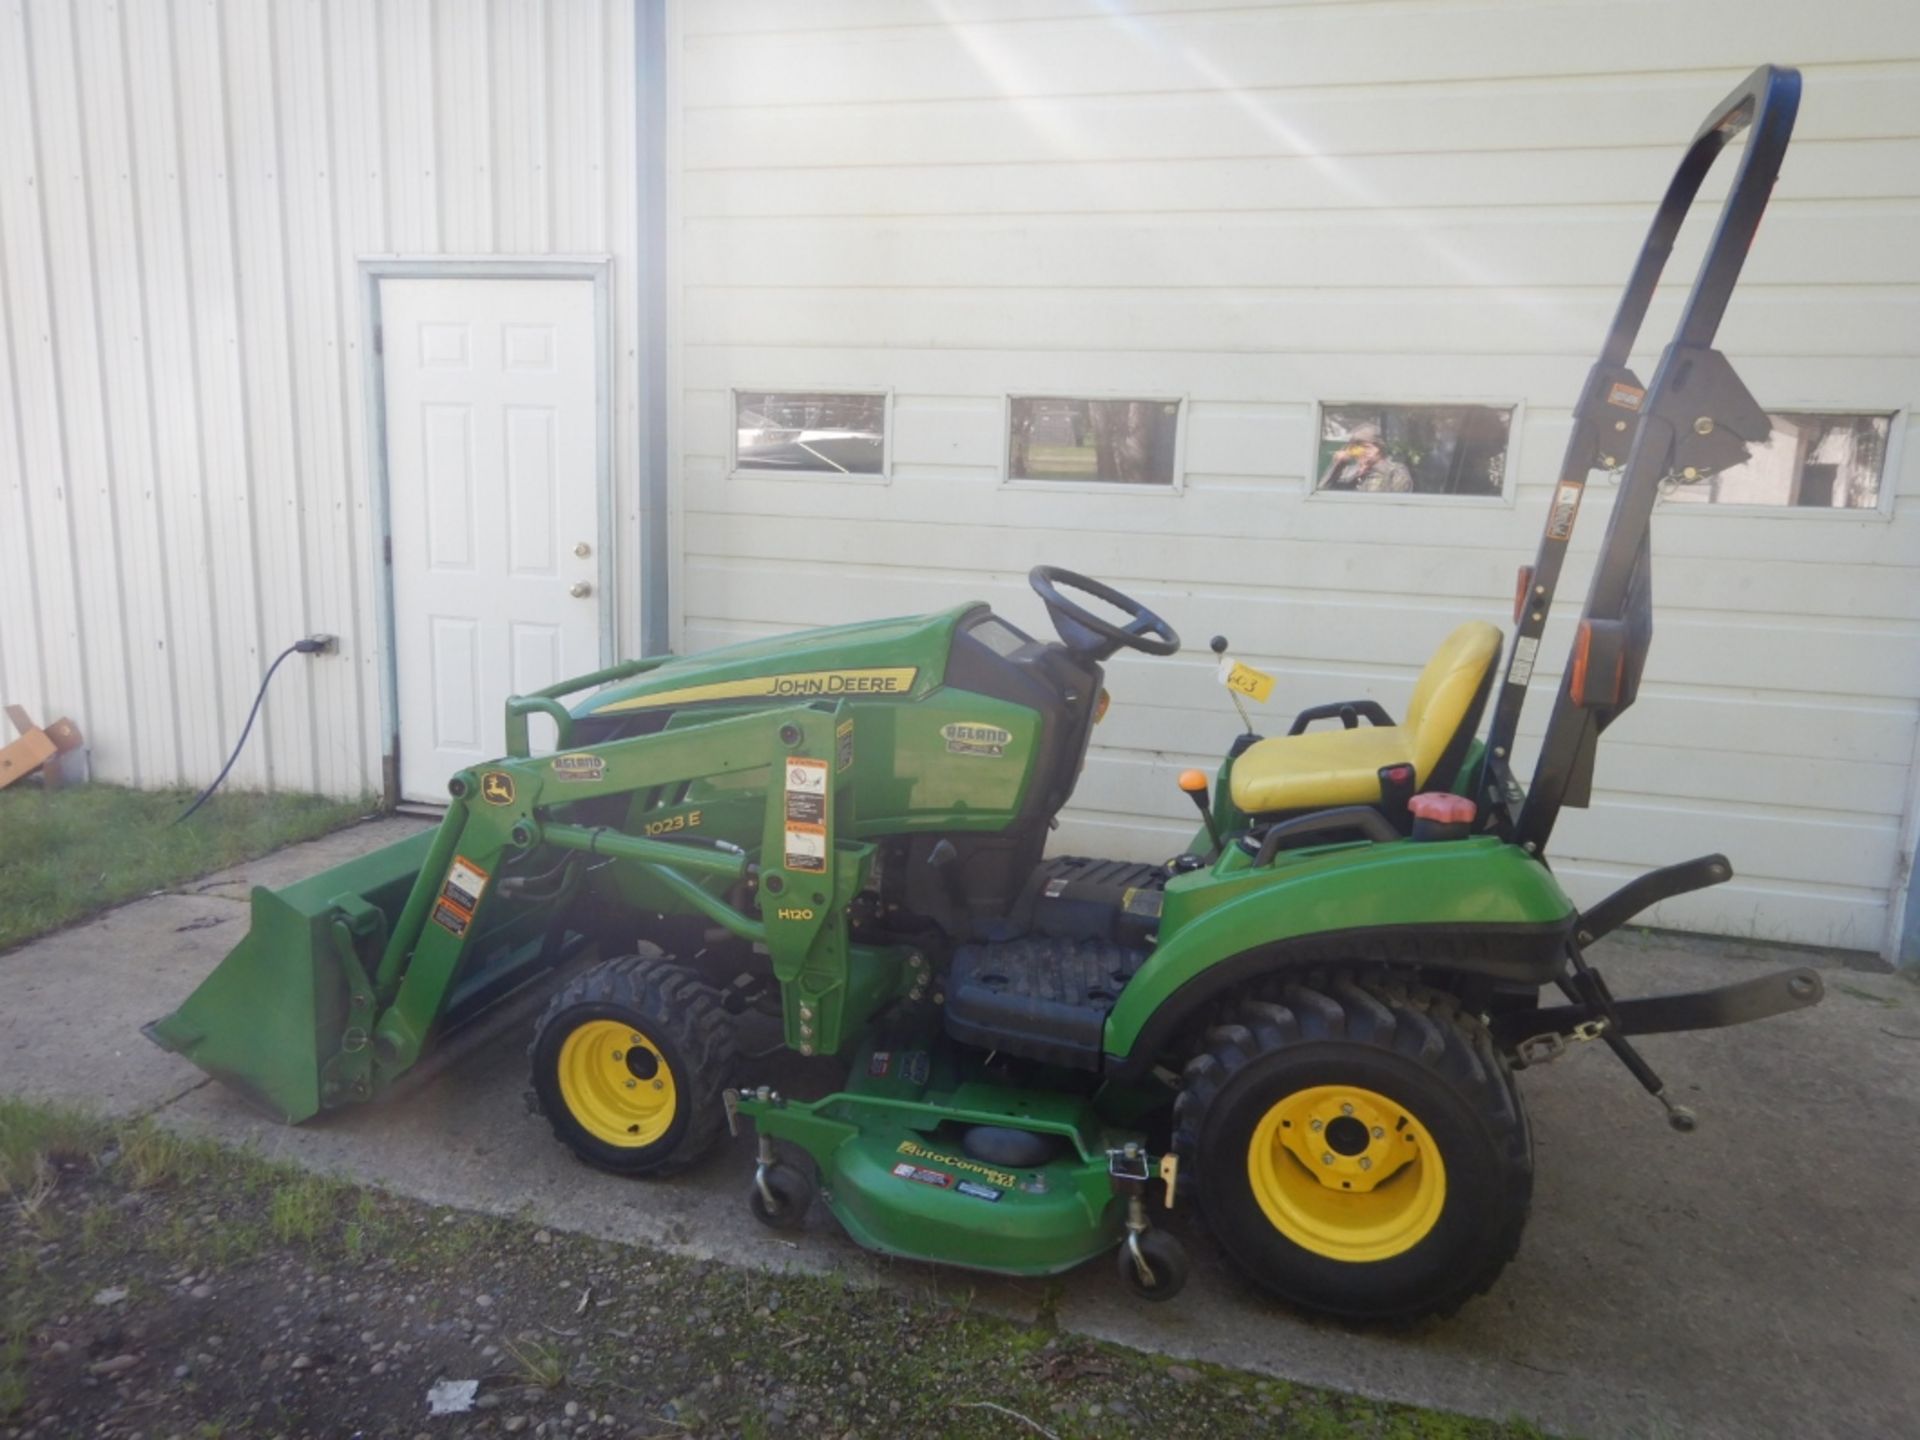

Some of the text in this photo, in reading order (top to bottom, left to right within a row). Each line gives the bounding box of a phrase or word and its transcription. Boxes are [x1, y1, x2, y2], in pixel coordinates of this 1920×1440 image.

[767, 675, 897, 695] JOHN DEERE
[945, 725, 1008, 744] AGLAND
[644, 810, 701, 837] 1023 E
[778, 907, 814, 920] H120
[897, 1141, 1016, 1182] AutoConnect
